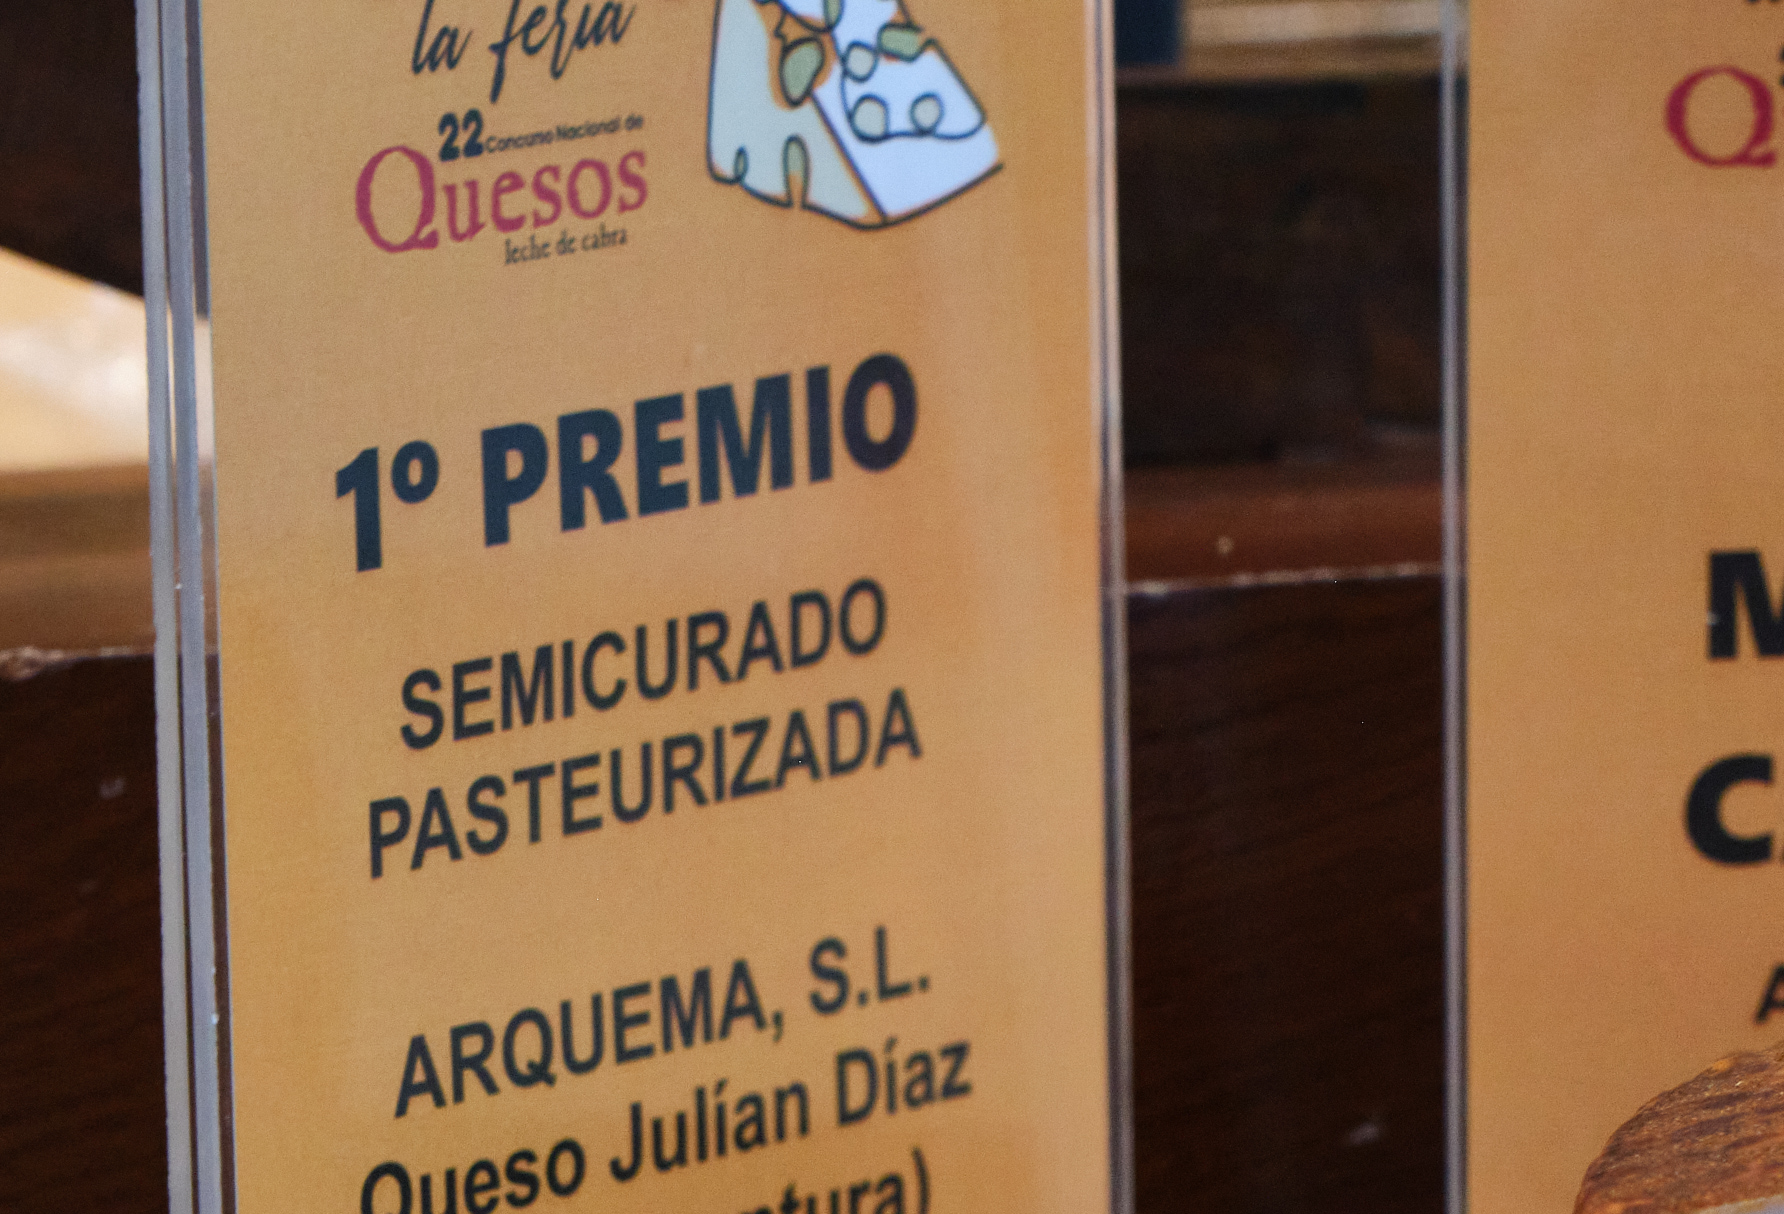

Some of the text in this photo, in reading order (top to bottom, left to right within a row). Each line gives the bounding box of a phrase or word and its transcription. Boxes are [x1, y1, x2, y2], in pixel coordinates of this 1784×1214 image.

[355, 145, 649, 254] Quesos
[438, 108, 484, 162] 22
[555, 114, 622, 143] Nacional
[624, 112, 645, 131] de
[504, 221, 629, 266] leche de cabra
[335, 353, 919, 573] 1º PREMIO
[400, 578, 887, 752] SEMICURADO
[368, 686, 923, 881] PASTEURIZADA
[394, 925, 930, 1119] ARQUEMA, S.L.
[610, 1078, 810, 1183] Julían
[836, 1036, 973, 1128] Díaz
